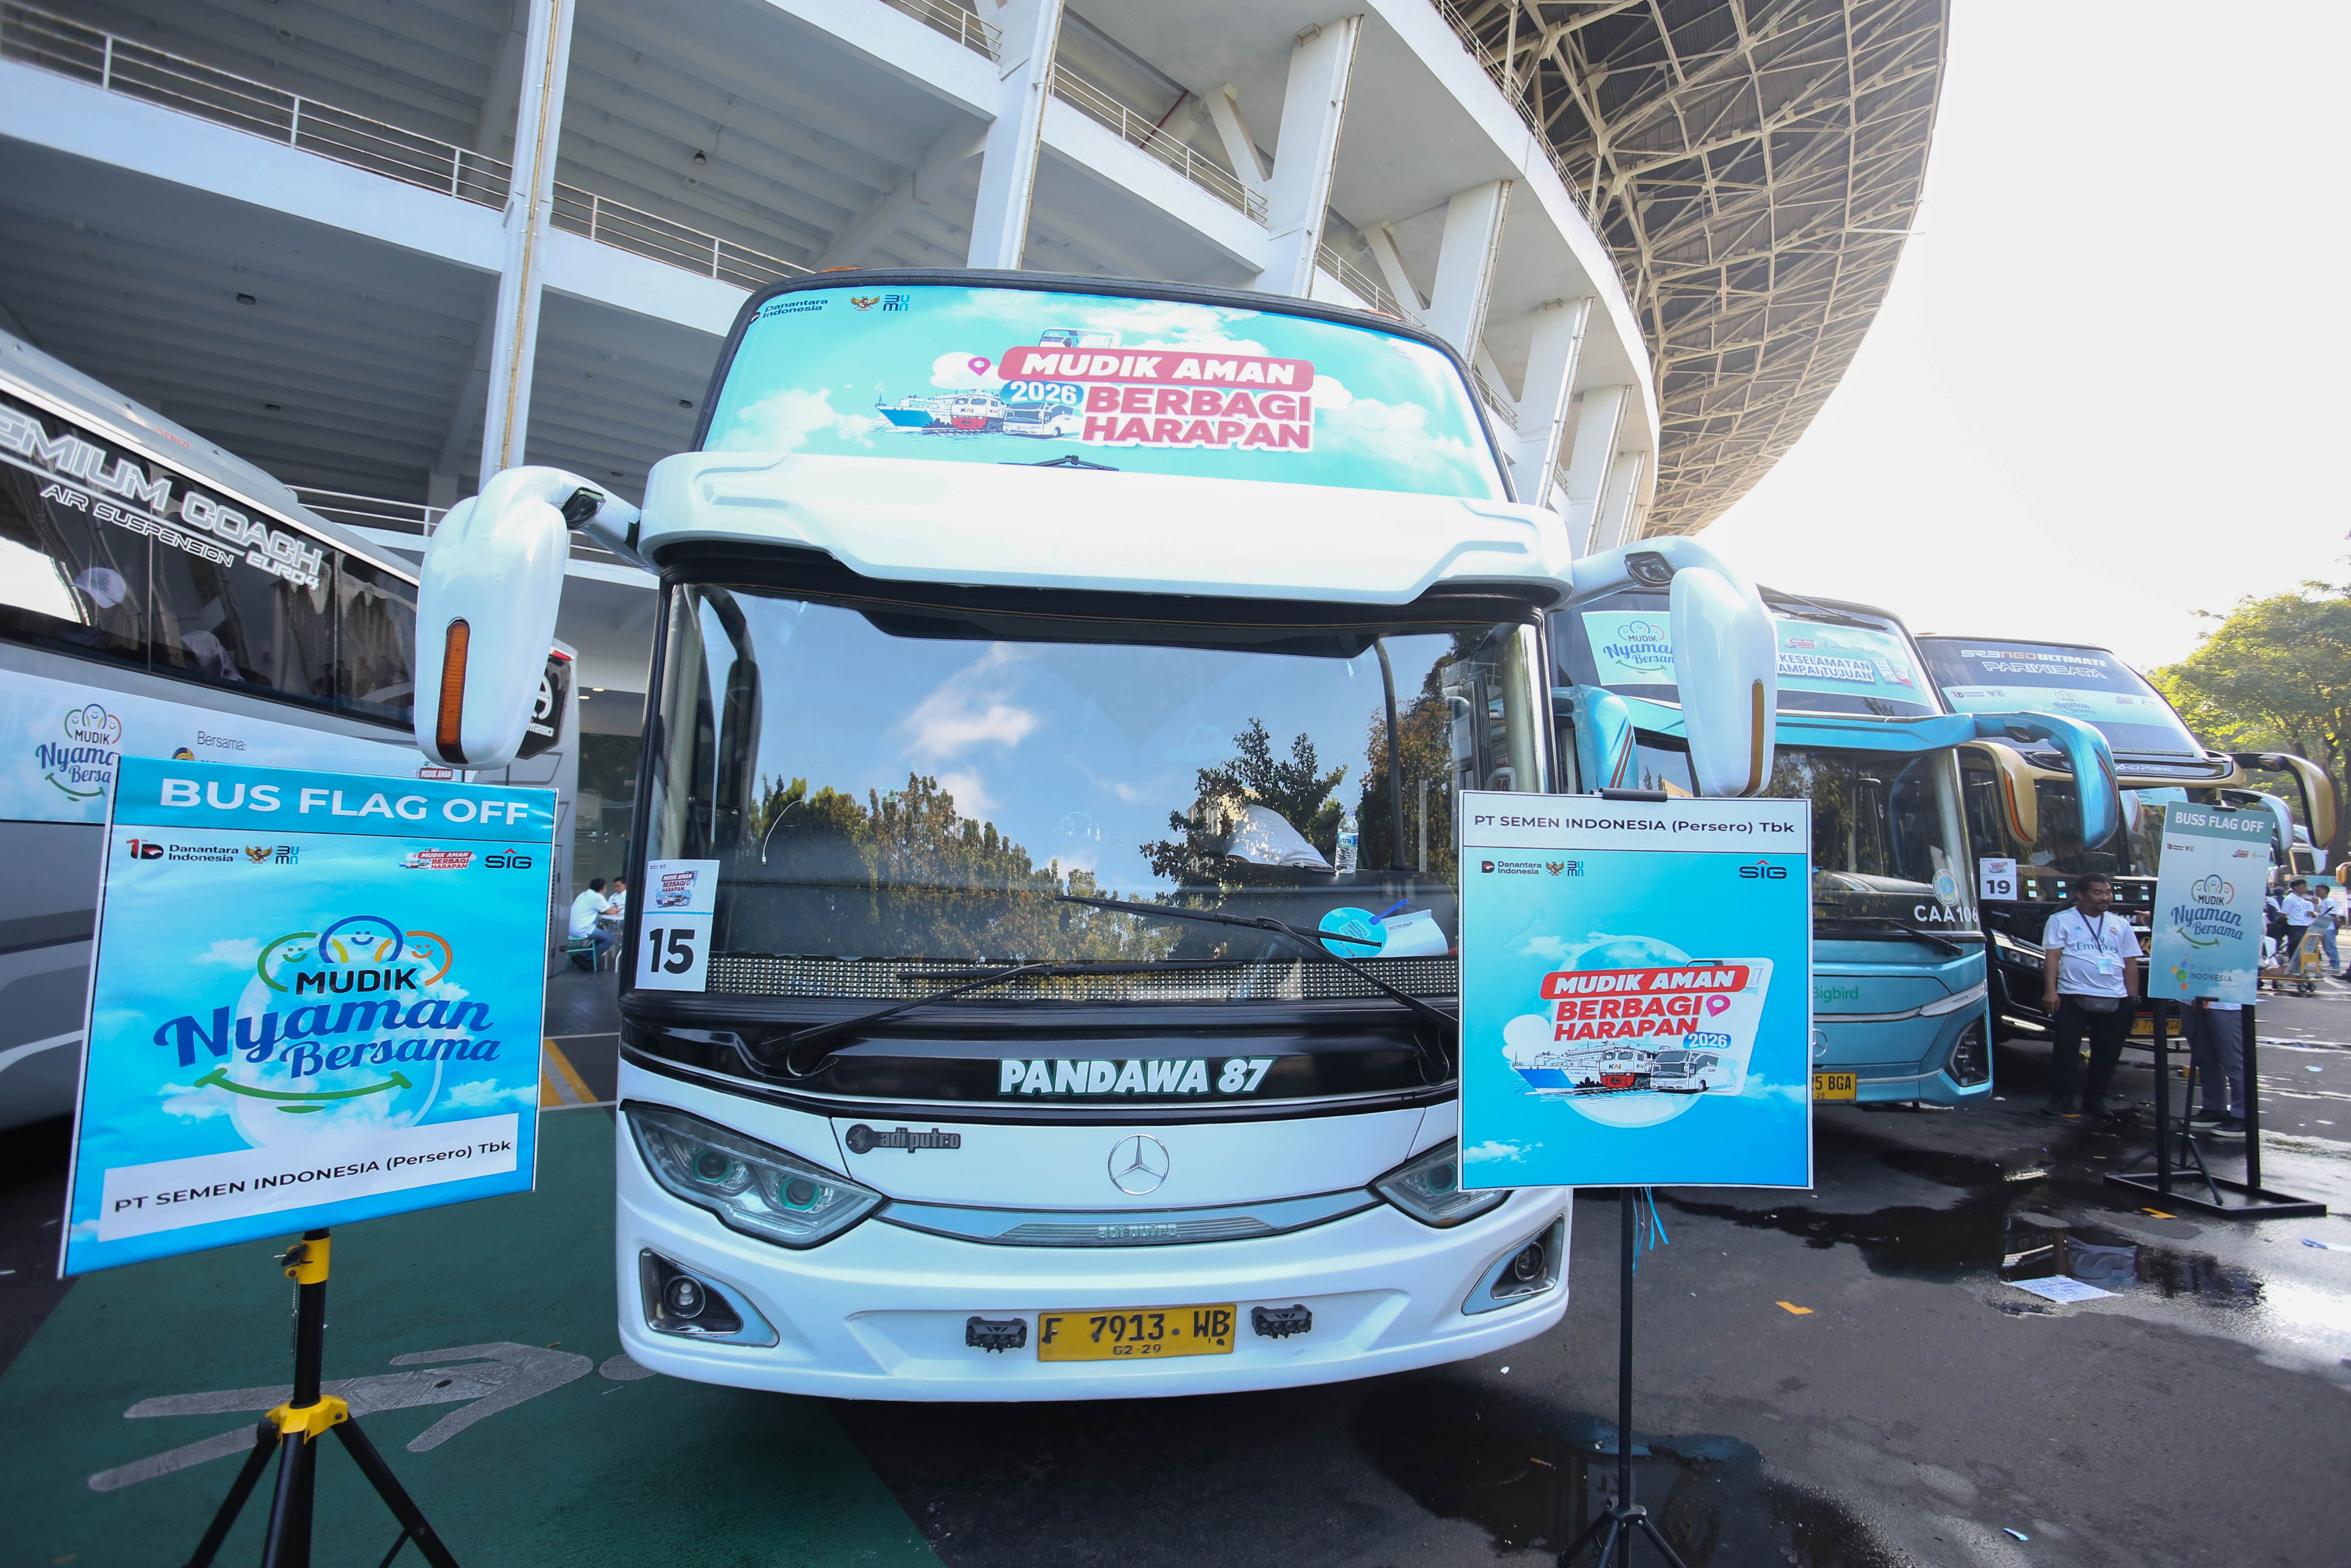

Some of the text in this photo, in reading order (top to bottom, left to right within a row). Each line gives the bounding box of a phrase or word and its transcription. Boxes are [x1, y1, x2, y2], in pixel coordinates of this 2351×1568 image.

[762, 305, 822, 318] Indonesia
[764, 298, 828, 312] Danantara
[1021, 353, 1295, 385] MUDIK AMAN
[1010, 381, 1077, 402] 2026
[1085, 386, 1311, 422] BERBAGI
[1082, 416, 1310, 450] HARAPAN
[40, 484, 235, 568] AIR SUSPENSION
[181, 491, 323, 576] COACH
[246, 550, 320, 591] EURO4
[1632, 654, 1674, 664] Bersam
[1779, 654, 1869, 670] KESELAMATAN
[1821, 668, 1872, 682] TUJUAN
[1981, 662, 2108, 679] PARIWISATA
[2052, 701, 2091, 710] Nyaman
[75, 729, 111, 745] MUDIK
[197, 731, 246, 751] Bersama:
[36, 742, 119, 772] Nyama
[69, 765, 111, 783] Bersa
[160, 778, 529, 825] BUS FLAG OFF
[1475, 815, 1796, 835] PT SEMEN INDONESIA (Persero) Tbk
[2175, 811, 2264, 833] BUSS FLAG OFF
[169, 844, 239, 854] Danantara
[169, 853, 234, 862] Indonesia
[485, 855, 533, 869] SIG
[1739, 866, 1787, 879] SIG
[1986, 880, 2011, 894] 19
[2197, 895, 2225, 906] MUDIK
[2170, 904, 2242, 927] Nyaman
[2192, 921, 2244, 940] Bersama
[649, 928, 695, 974] 15
[296, 967, 418, 995] MUDIK
[1553, 970, 1736, 995] MUDIK AMAN
[2189, 972, 2232, 982] INDONESIA
[1555, 995, 1703, 1022] BERBAGI
[153, 999, 494, 1067] Nyaman
[1553, 1017, 1699, 1042] HARAPAN
[1687, 1033, 1728, 1048] 2026
[279, 1037, 501, 1079] Bersama
[999, 1058, 1274, 1095] PANDAWA 87
[1828, 1076, 1852, 1090] BGA
[115, 1140, 512, 1212] PT SEMEN INDONESIA (Persero) Tbk
[1042, 1310, 1231, 1344] F 7913 WB
